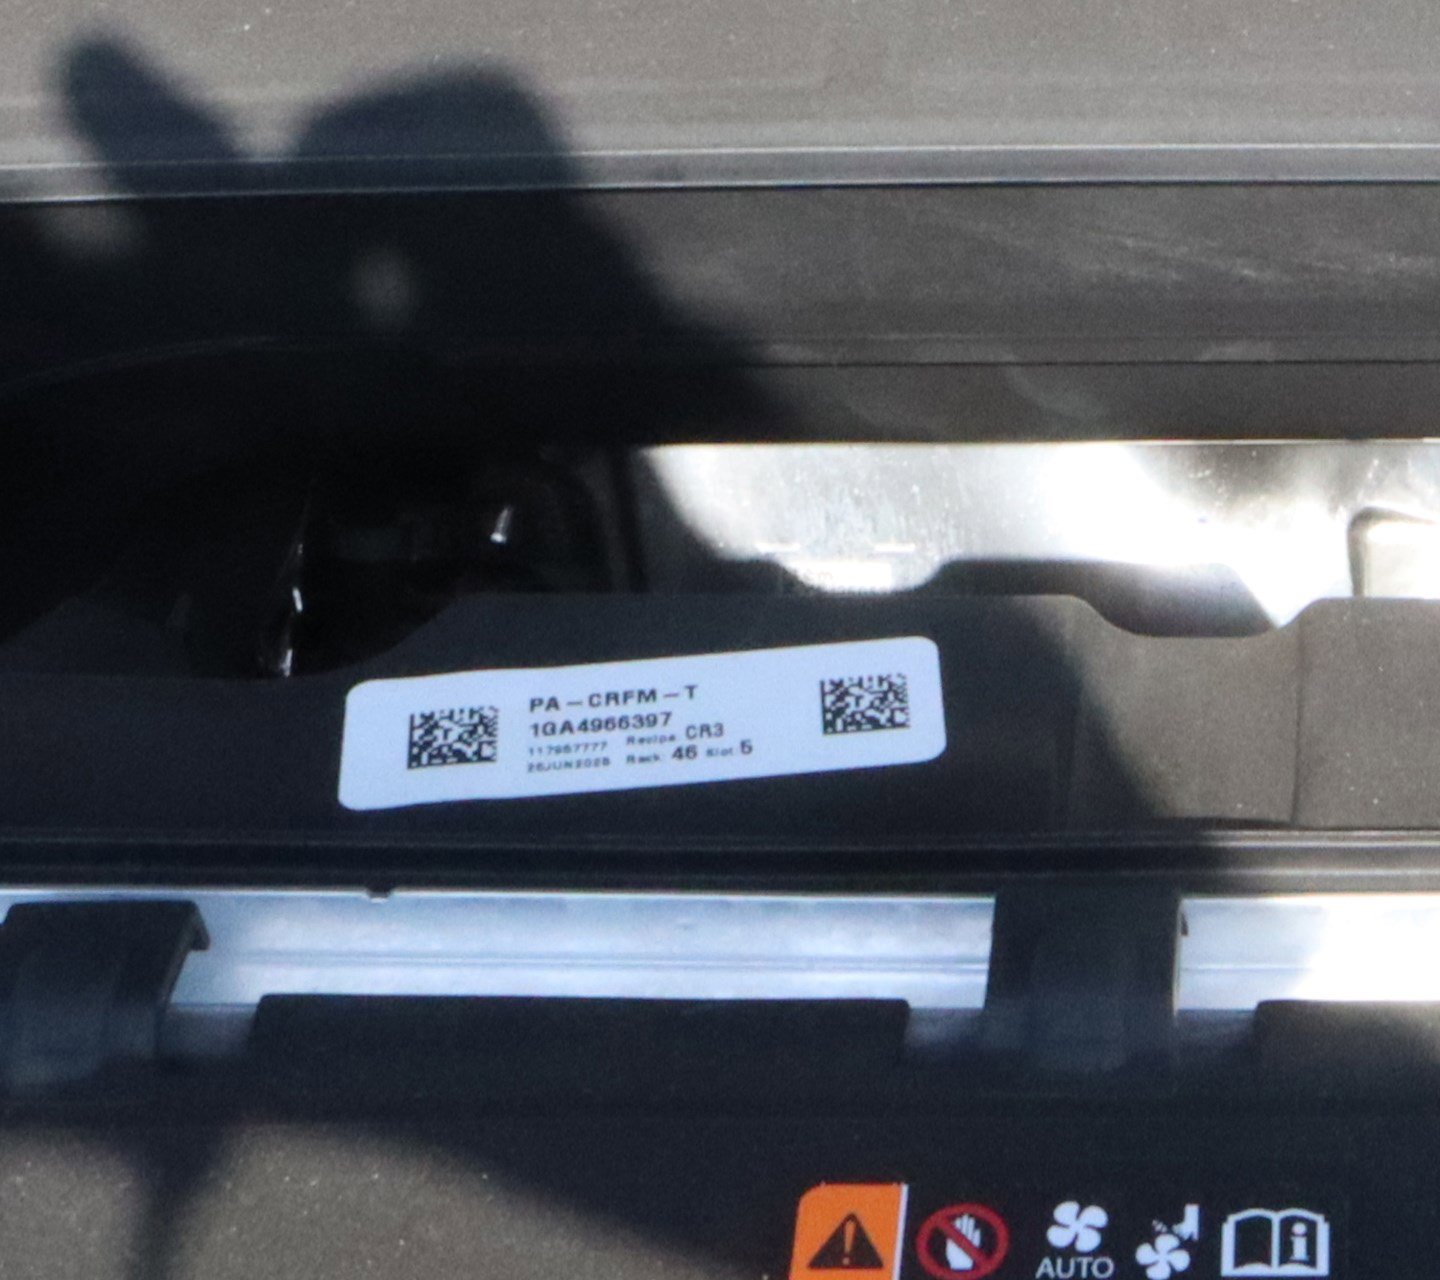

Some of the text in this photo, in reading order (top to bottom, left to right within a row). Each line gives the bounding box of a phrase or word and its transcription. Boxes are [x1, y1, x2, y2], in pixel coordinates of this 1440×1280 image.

[685, 722, 724, 740] CR3
[671, 744, 698, 760] 46
[1034, 1257, 1115, 1279] AUTO
